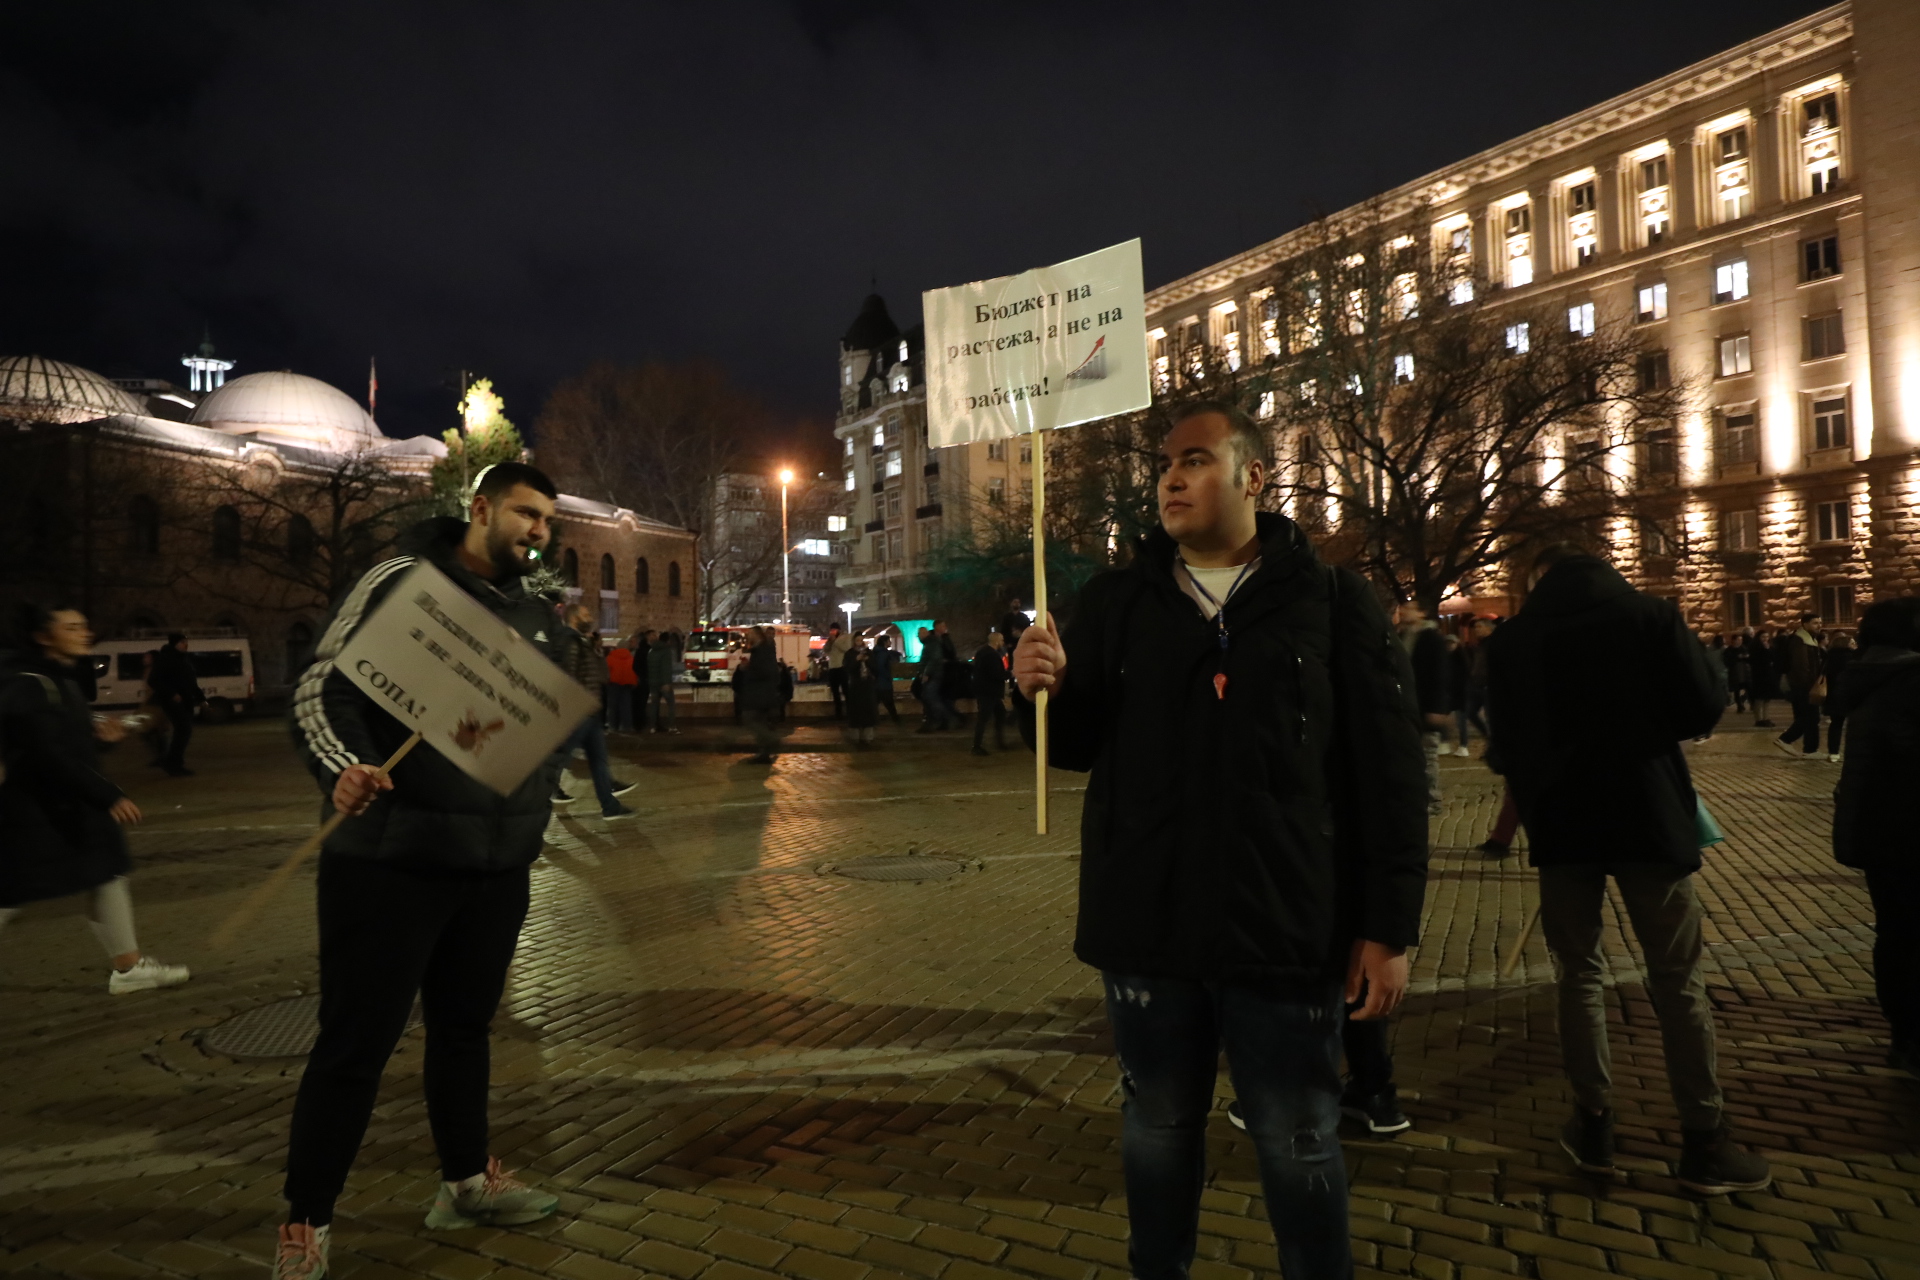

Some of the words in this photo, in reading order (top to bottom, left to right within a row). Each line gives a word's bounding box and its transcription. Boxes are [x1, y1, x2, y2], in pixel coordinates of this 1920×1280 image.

[975, 292, 1059, 324] Бюджет
[1067, 284, 1092, 303] на
[947, 328, 1040, 365] растежа,
[1047, 325, 1058, 339] а
[1067, 315, 1091, 335] не
[1097, 306, 1123, 327] на
[356, 659, 427, 720] СОПА!
